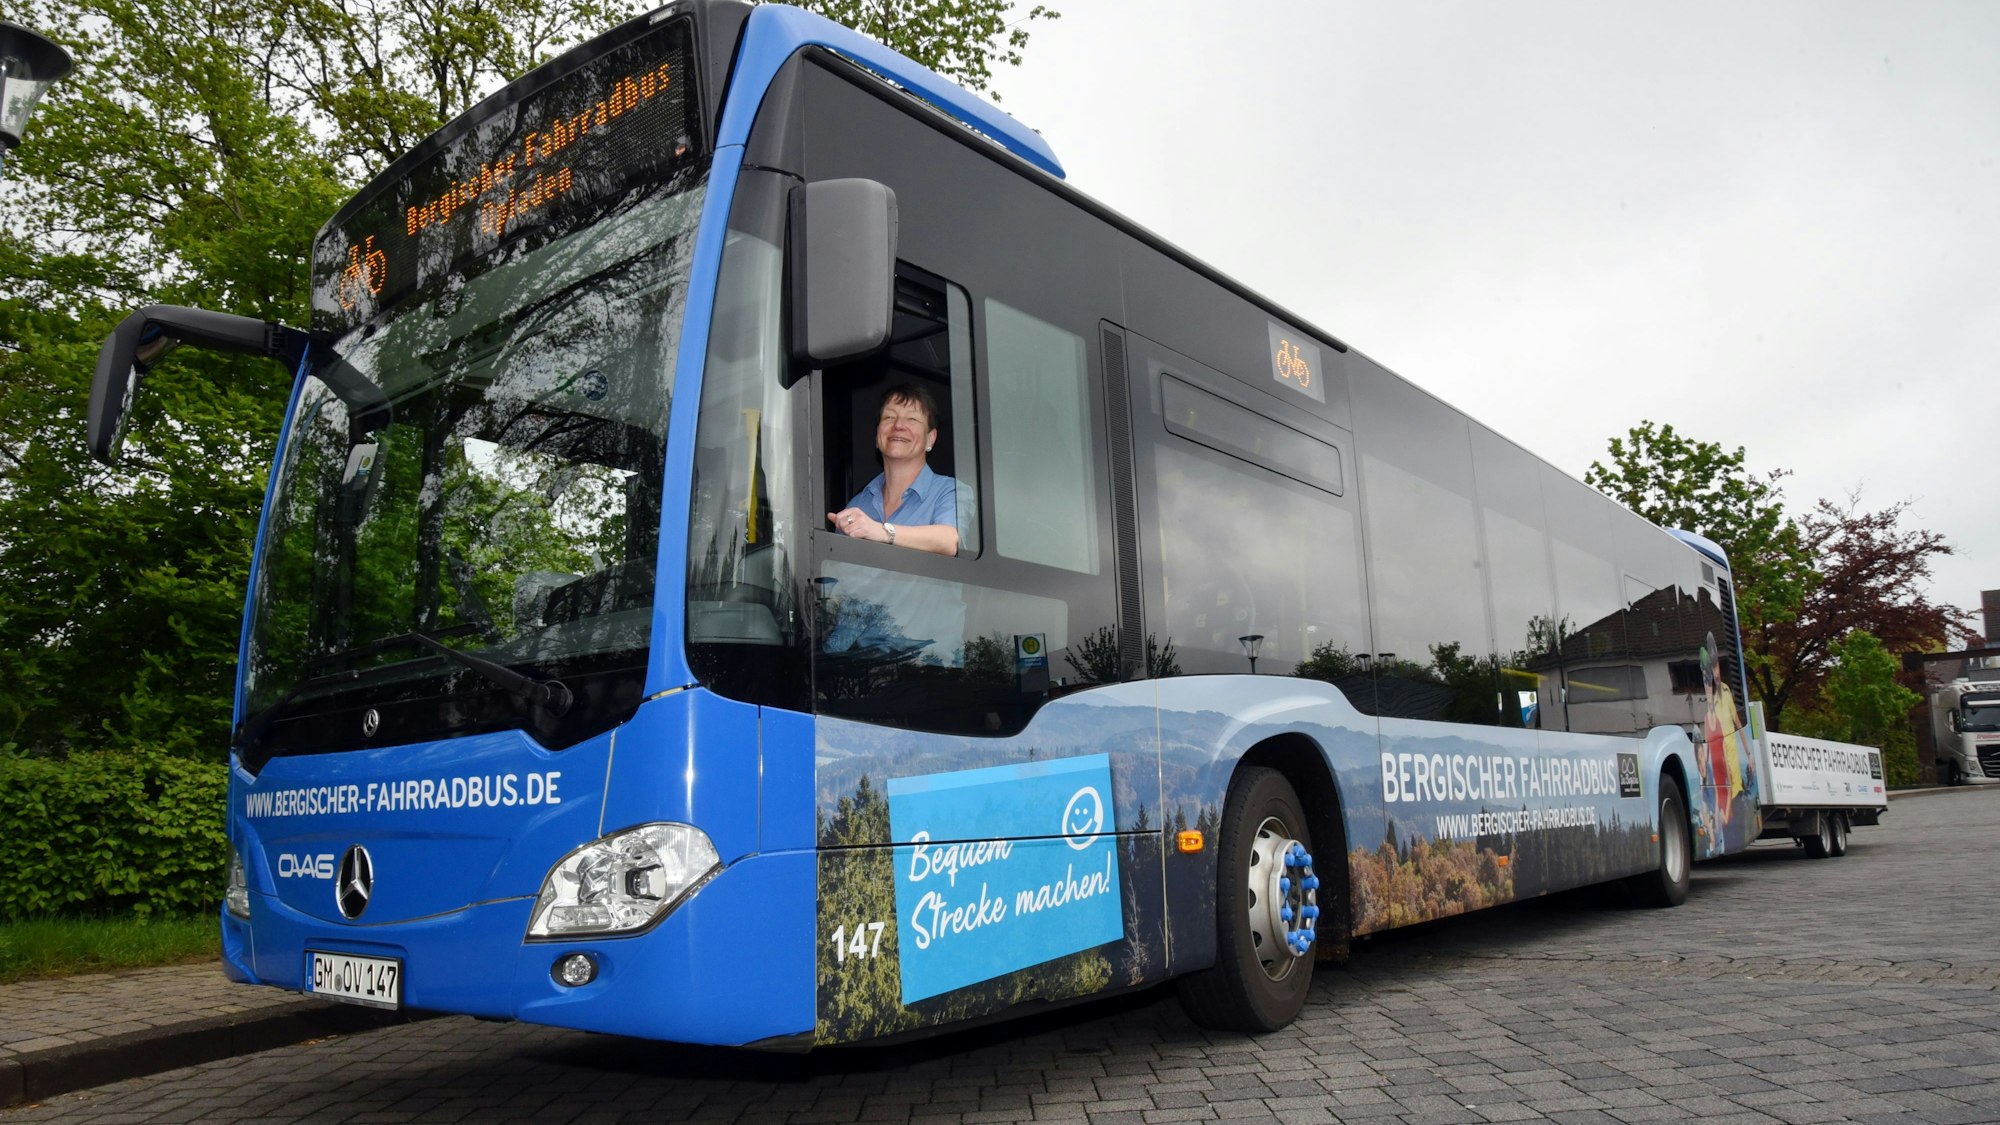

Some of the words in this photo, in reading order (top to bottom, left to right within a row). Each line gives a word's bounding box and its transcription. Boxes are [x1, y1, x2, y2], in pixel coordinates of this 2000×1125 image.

[407, 152, 516, 236] Bergischer
[525, 63, 671, 166] Fahrradbus
[482, 167, 572, 236] Opladen
[1381, 752, 1517, 802] BERGISCHER
[1519, 756, 1617, 798] FAHRRADBUS
[1771, 742, 1823, 771] BERGISCHER
[1823, 748, 1869, 775] FAHRRADBUS
[246, 771, 561, 819] WWW.BERGISCHER-FAHRRADBUS.DE
[1436, 806, 1596, 839] WWW.BERGISCHER-FAHRRADBUS.DE
[278, 853, 335, 879] OVAG
[908, 830, 1013, 887] Bequem
[911, 882, 1007, 950] Strecke
[1015, 850, 1112, 917] machen!
[831, 921, 885, 962] 147
[315, 957, 333, 990] GM
[344, 961, 363, 993] OV
[367, 964, 397, 998] 147
